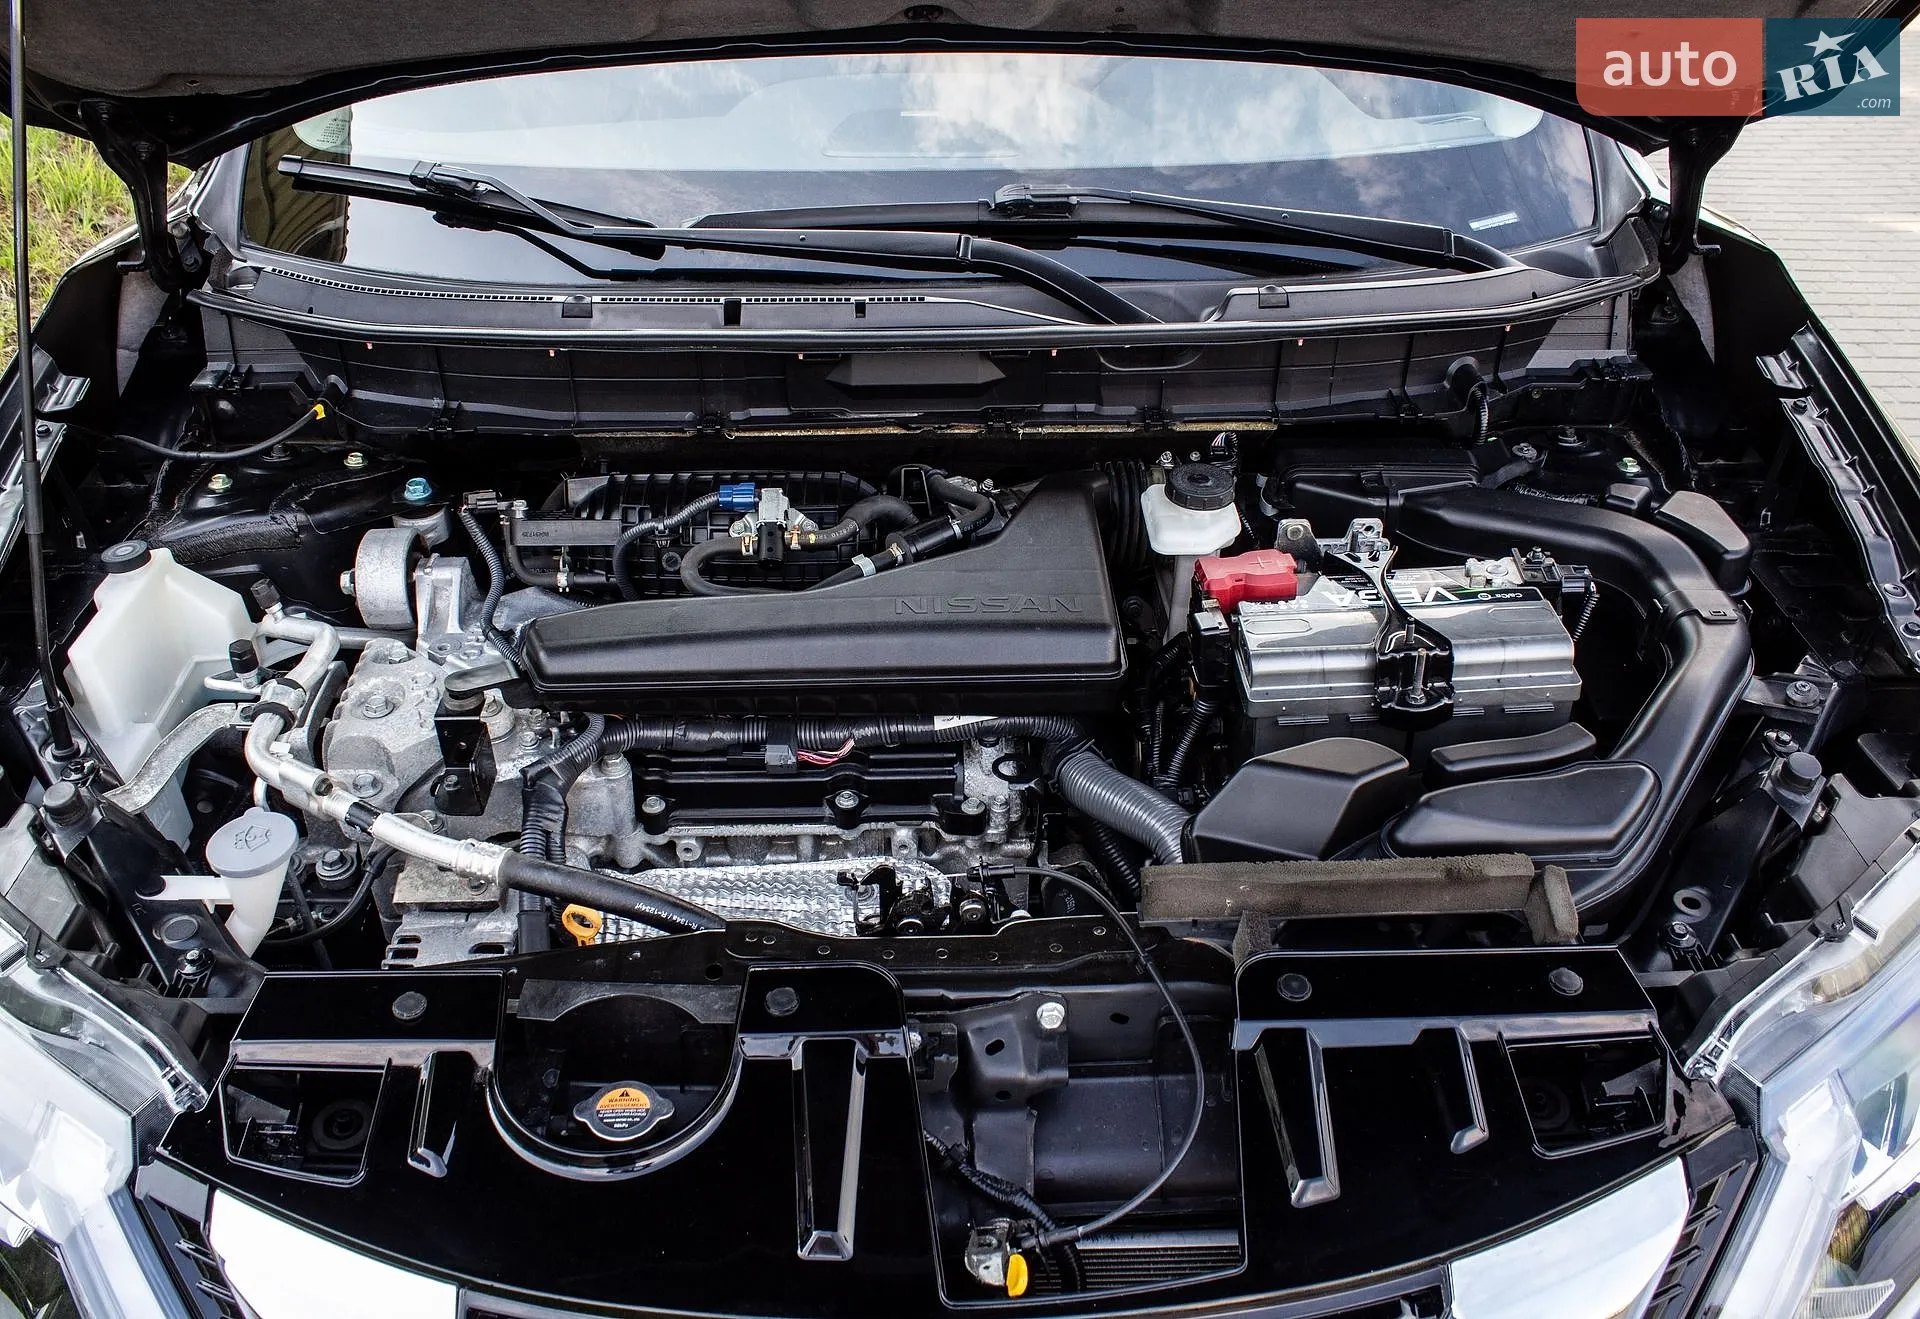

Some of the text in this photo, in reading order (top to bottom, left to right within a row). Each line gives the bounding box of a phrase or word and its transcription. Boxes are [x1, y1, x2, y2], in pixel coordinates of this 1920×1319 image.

[895, 595, 1083, 614] NISSAN
[634, 903, 666, 918] R-1234yf
[673, 914, 698, 930] R-134a
